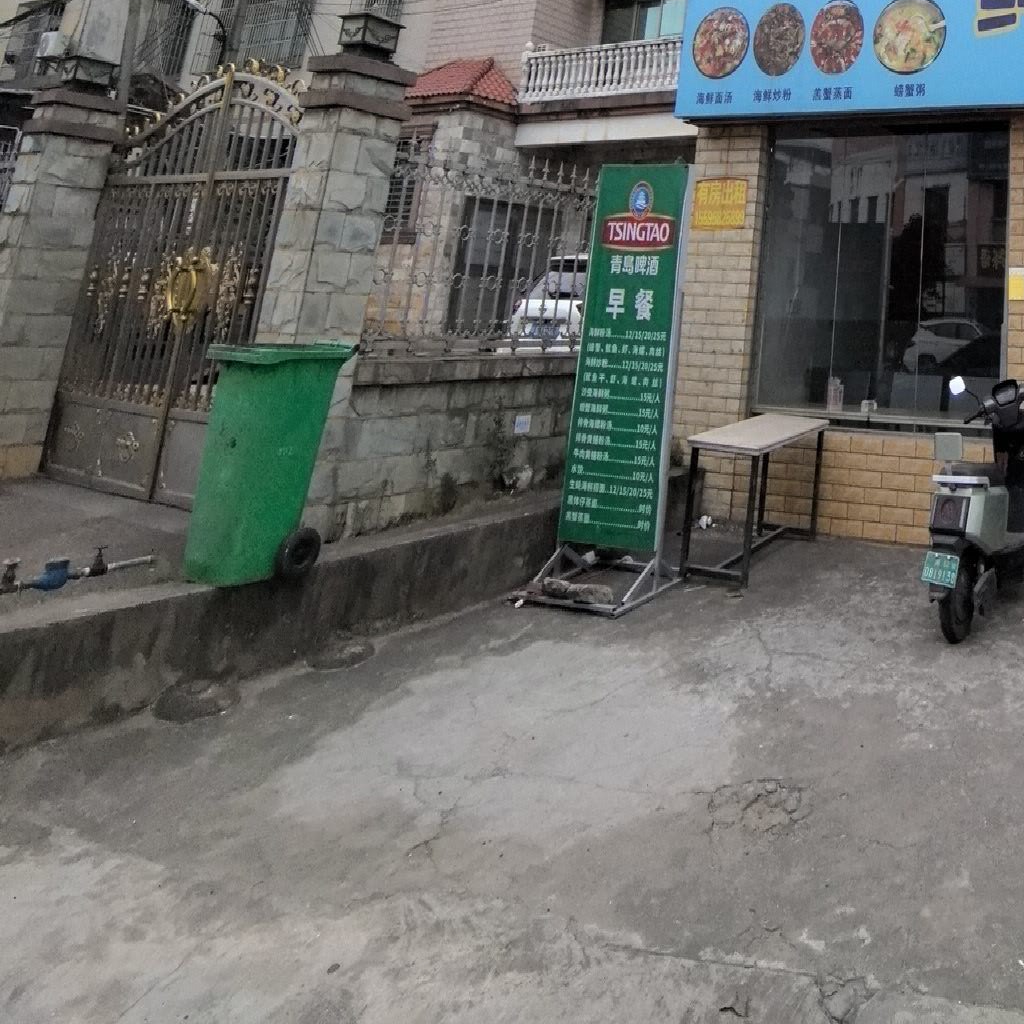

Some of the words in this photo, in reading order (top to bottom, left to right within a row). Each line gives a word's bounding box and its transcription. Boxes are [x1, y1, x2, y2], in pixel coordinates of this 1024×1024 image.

[752, 88, 792, 103] 海鲜炒粉
[894, 83, 926, 98] 螃蟹粥
[697, 182, 746, 205] 有房出租
[607, 222, 670, 242] TSINGTAO
[606, 288, 654, 321] 早餐
